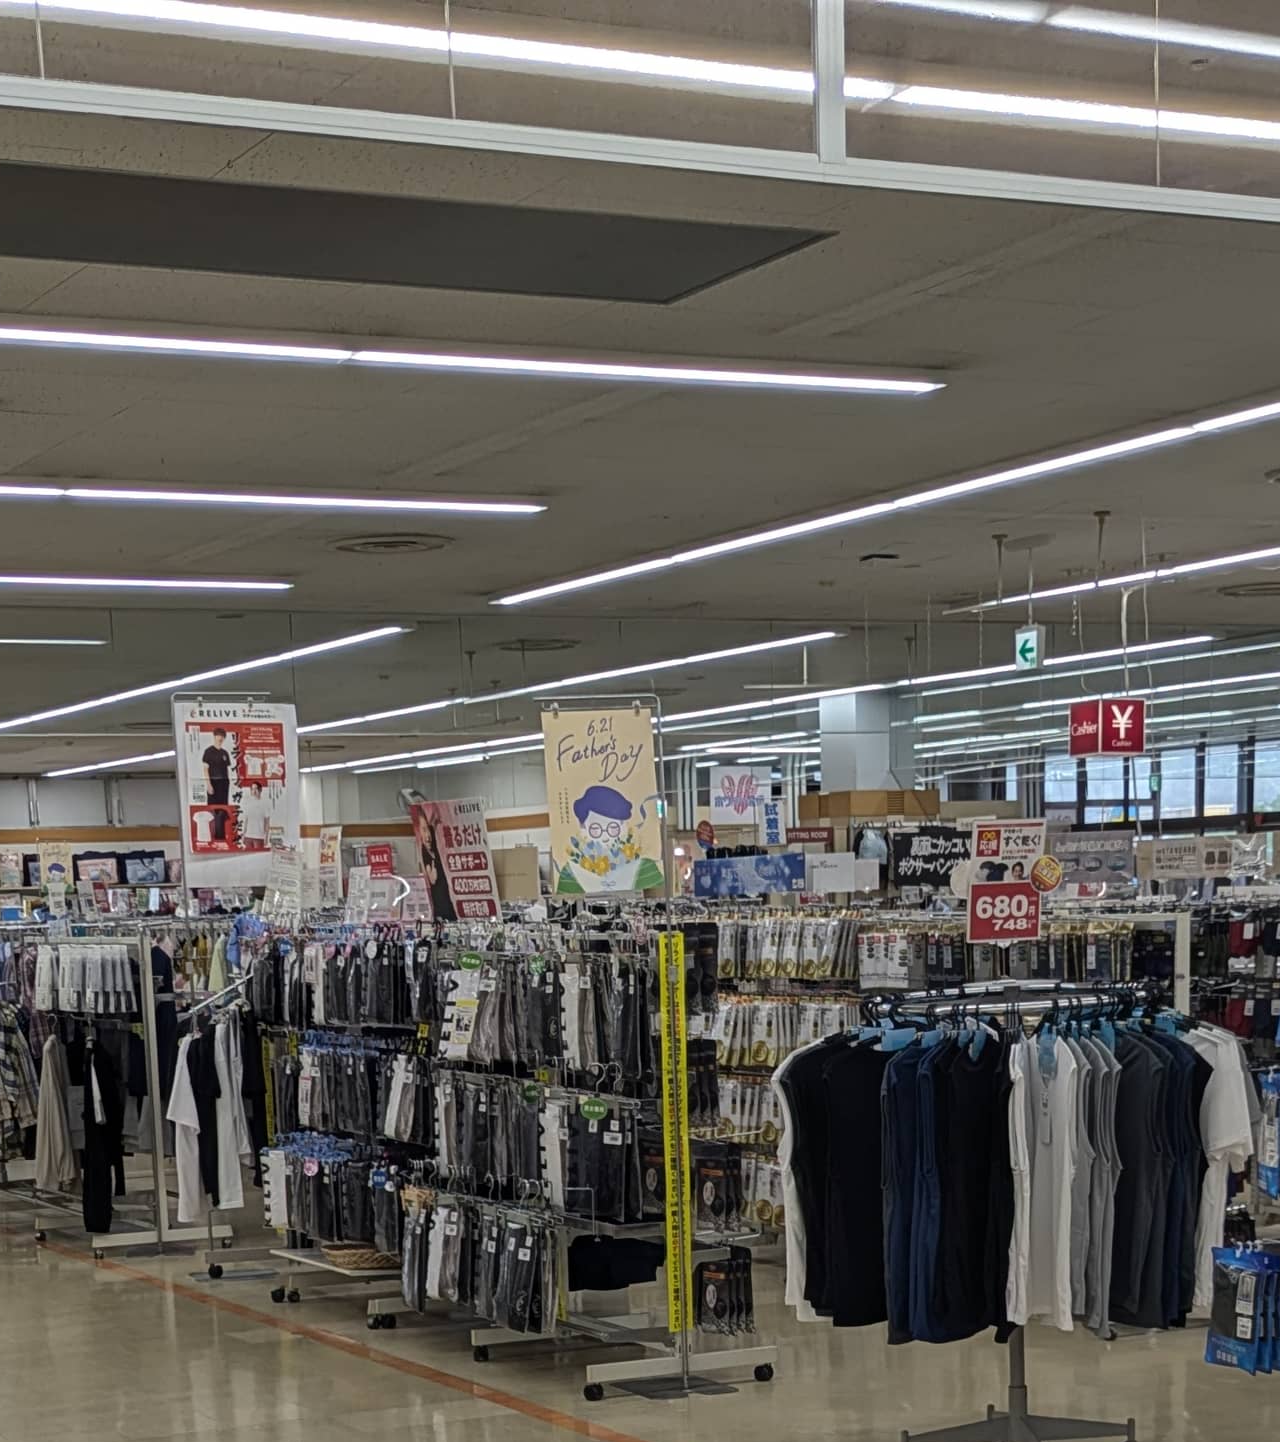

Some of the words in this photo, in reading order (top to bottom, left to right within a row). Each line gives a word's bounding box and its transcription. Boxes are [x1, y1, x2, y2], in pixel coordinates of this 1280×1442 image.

[199, 710, 238, 718] RELIVE
[587, 716, 614, 736] 6.21
[1071, 721, 1098, 736] Cashier
[557, 735, 616, 772] Father's
[599, 744, 644, 782] Day
[788, 831, 810, 840] FITTING
[810, 830, 828, 839] ROOM
[370, 854, 389, 864] SALE
